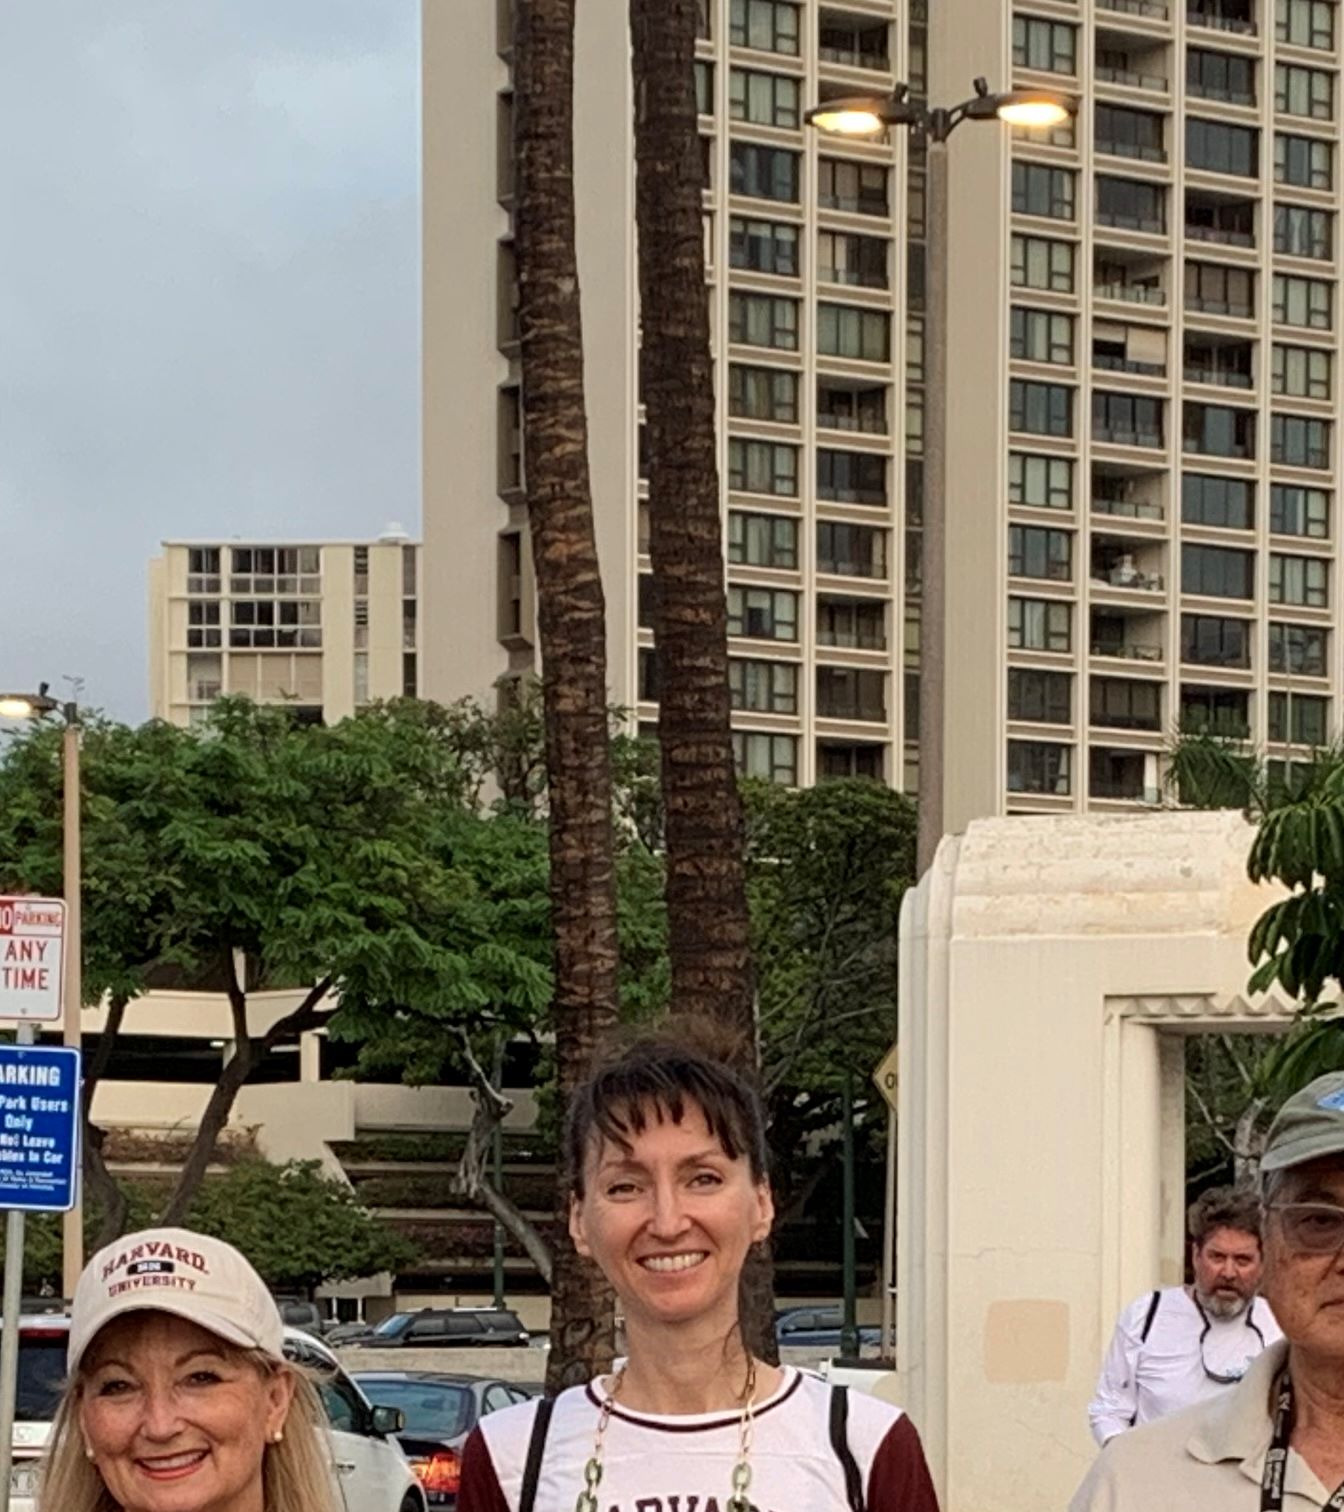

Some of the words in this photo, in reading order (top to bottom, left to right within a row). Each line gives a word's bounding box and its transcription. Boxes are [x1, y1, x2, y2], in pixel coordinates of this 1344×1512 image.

[16, 910, 62, 927] PARKING
[4, 939, 49, 963] ANY
[2, 966, 50, 991] TIME
[30, 1096, 69, 1113] Users
[4, 1113, 34, 1133] Only
[0, 1132, 20, 1147] Not
[23, 1134, 56, 1149] Leave
[43, 1151, 64, 1165] Car
[101, 1241, 210, 1282] HARVARD
[109, 1276, 196, 1298] UNIVERSITY
